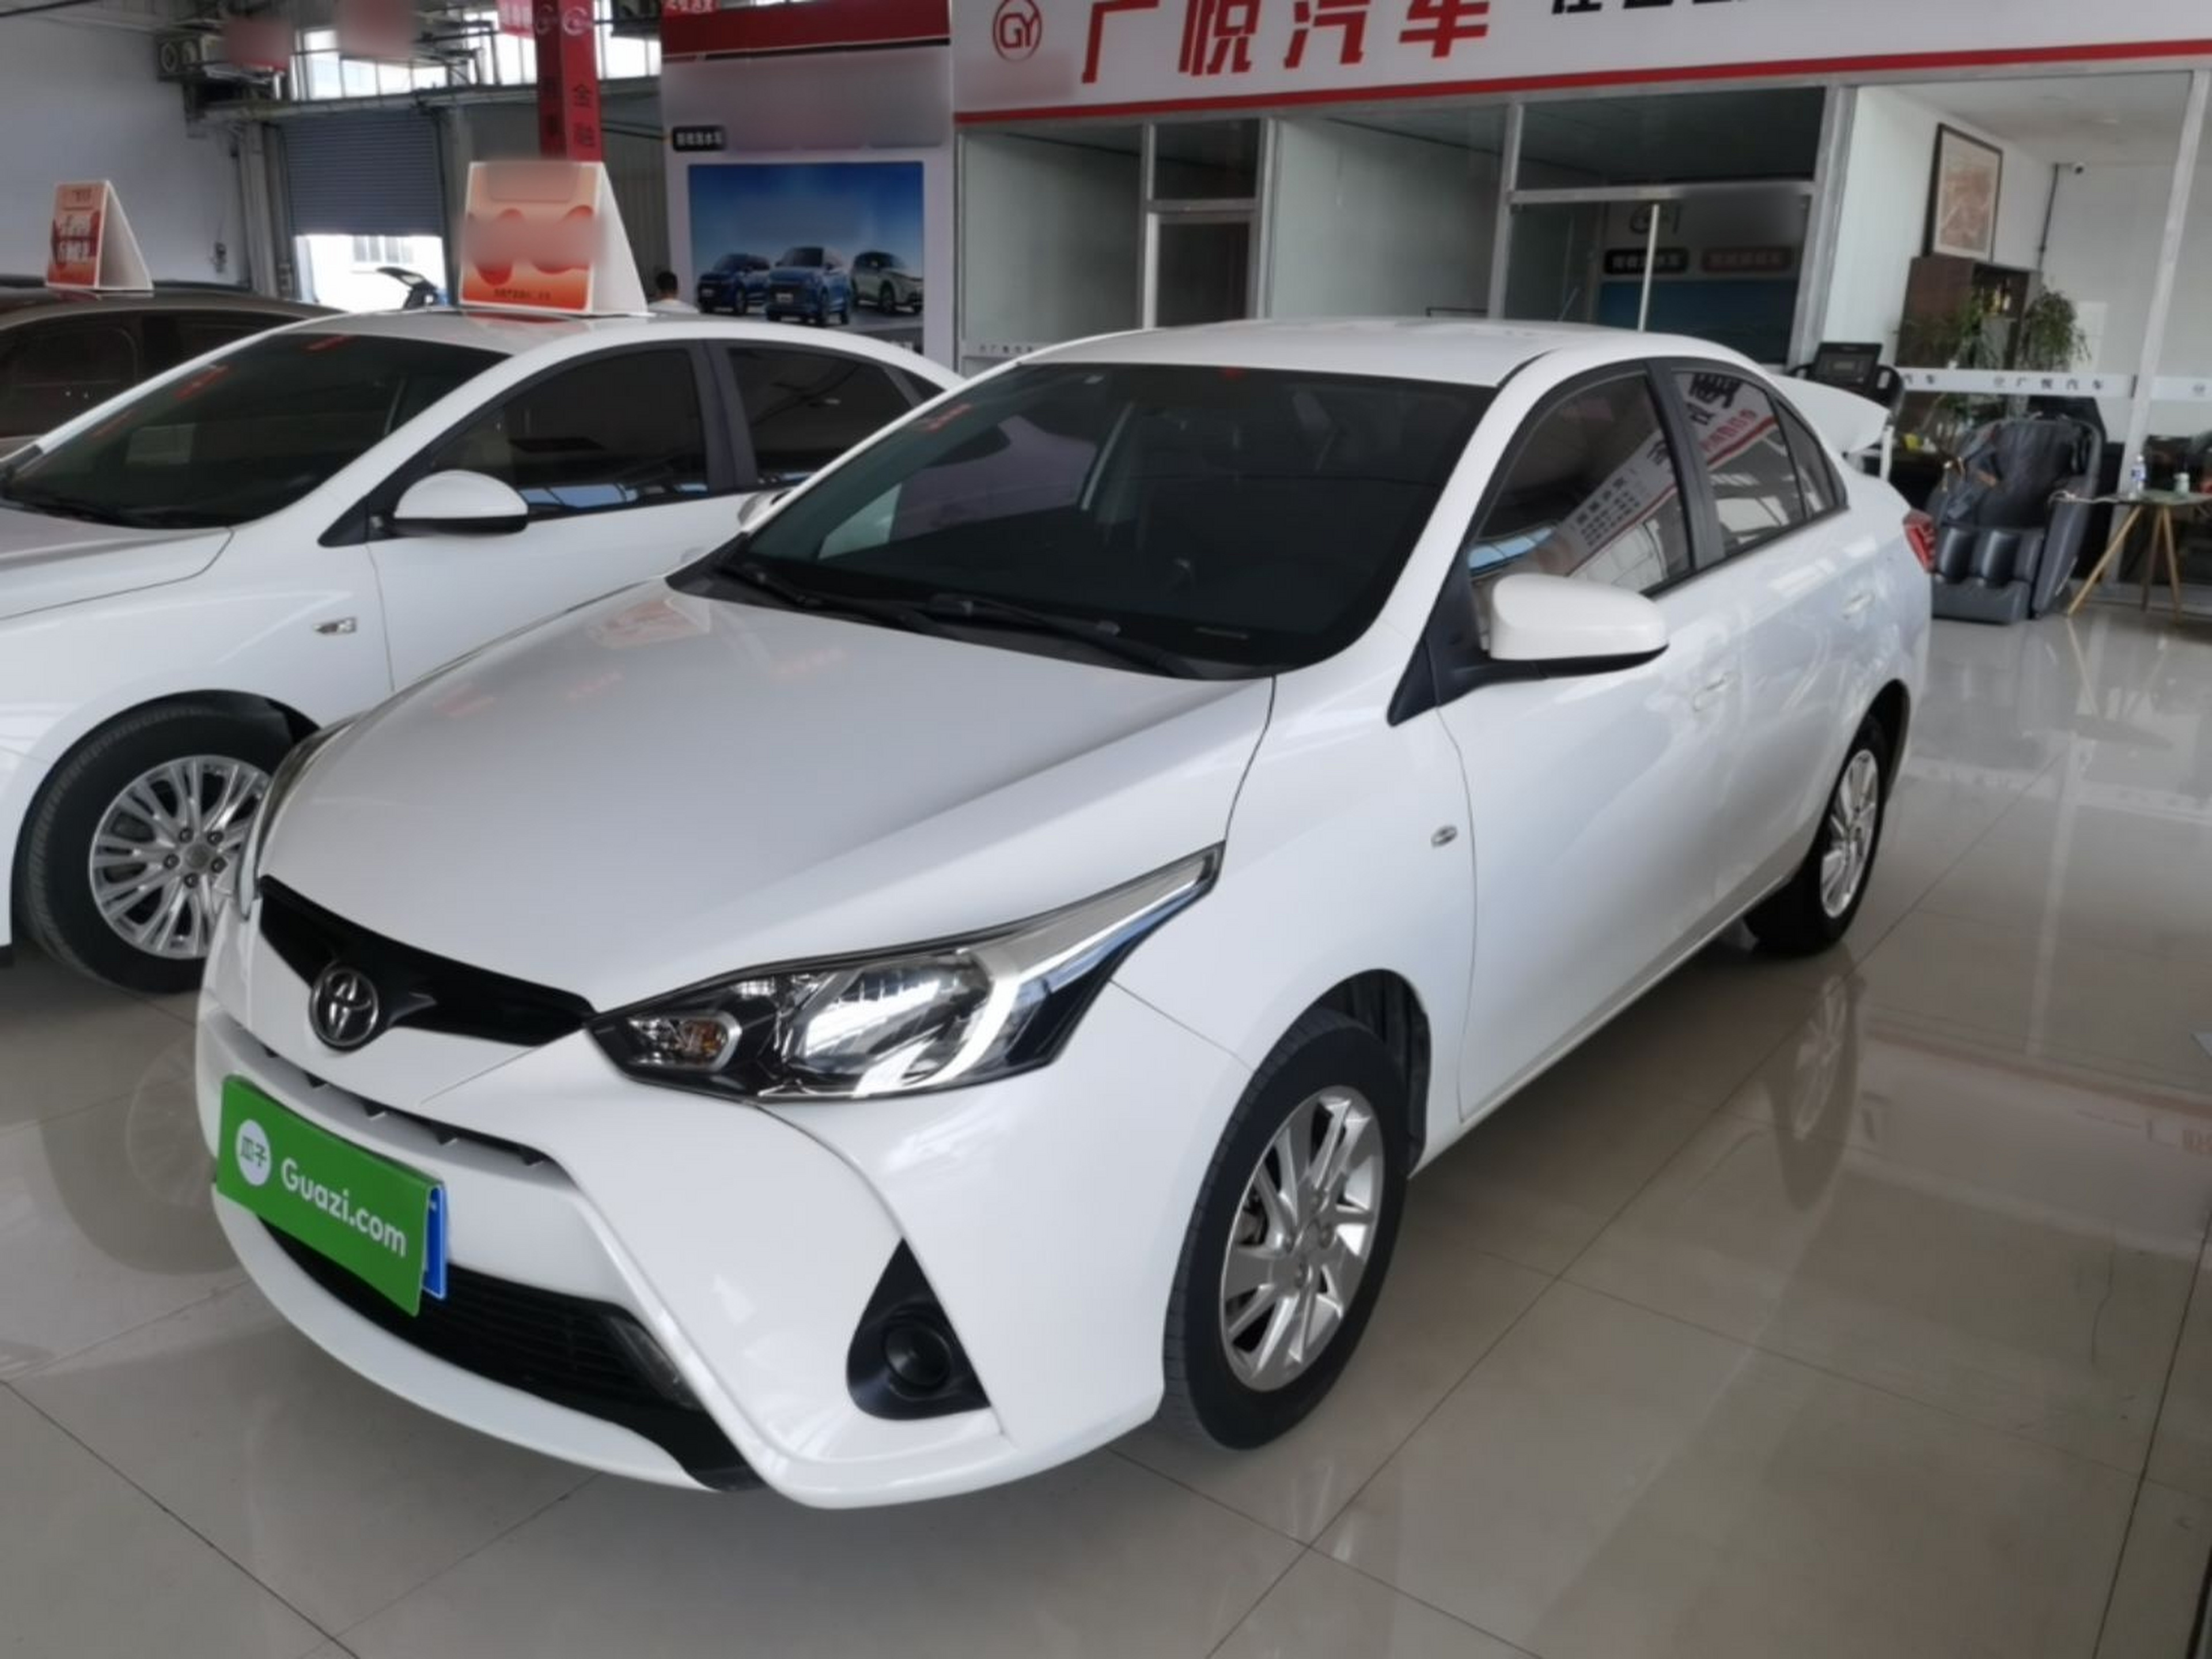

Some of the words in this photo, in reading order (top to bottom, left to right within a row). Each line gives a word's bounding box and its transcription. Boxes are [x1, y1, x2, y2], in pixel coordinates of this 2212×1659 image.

[999, 12, 1039, 48] GY
[1081, 0, 1490, 84] 广悦汽车
[282, 1158, 406, 1257] Guazi.com
